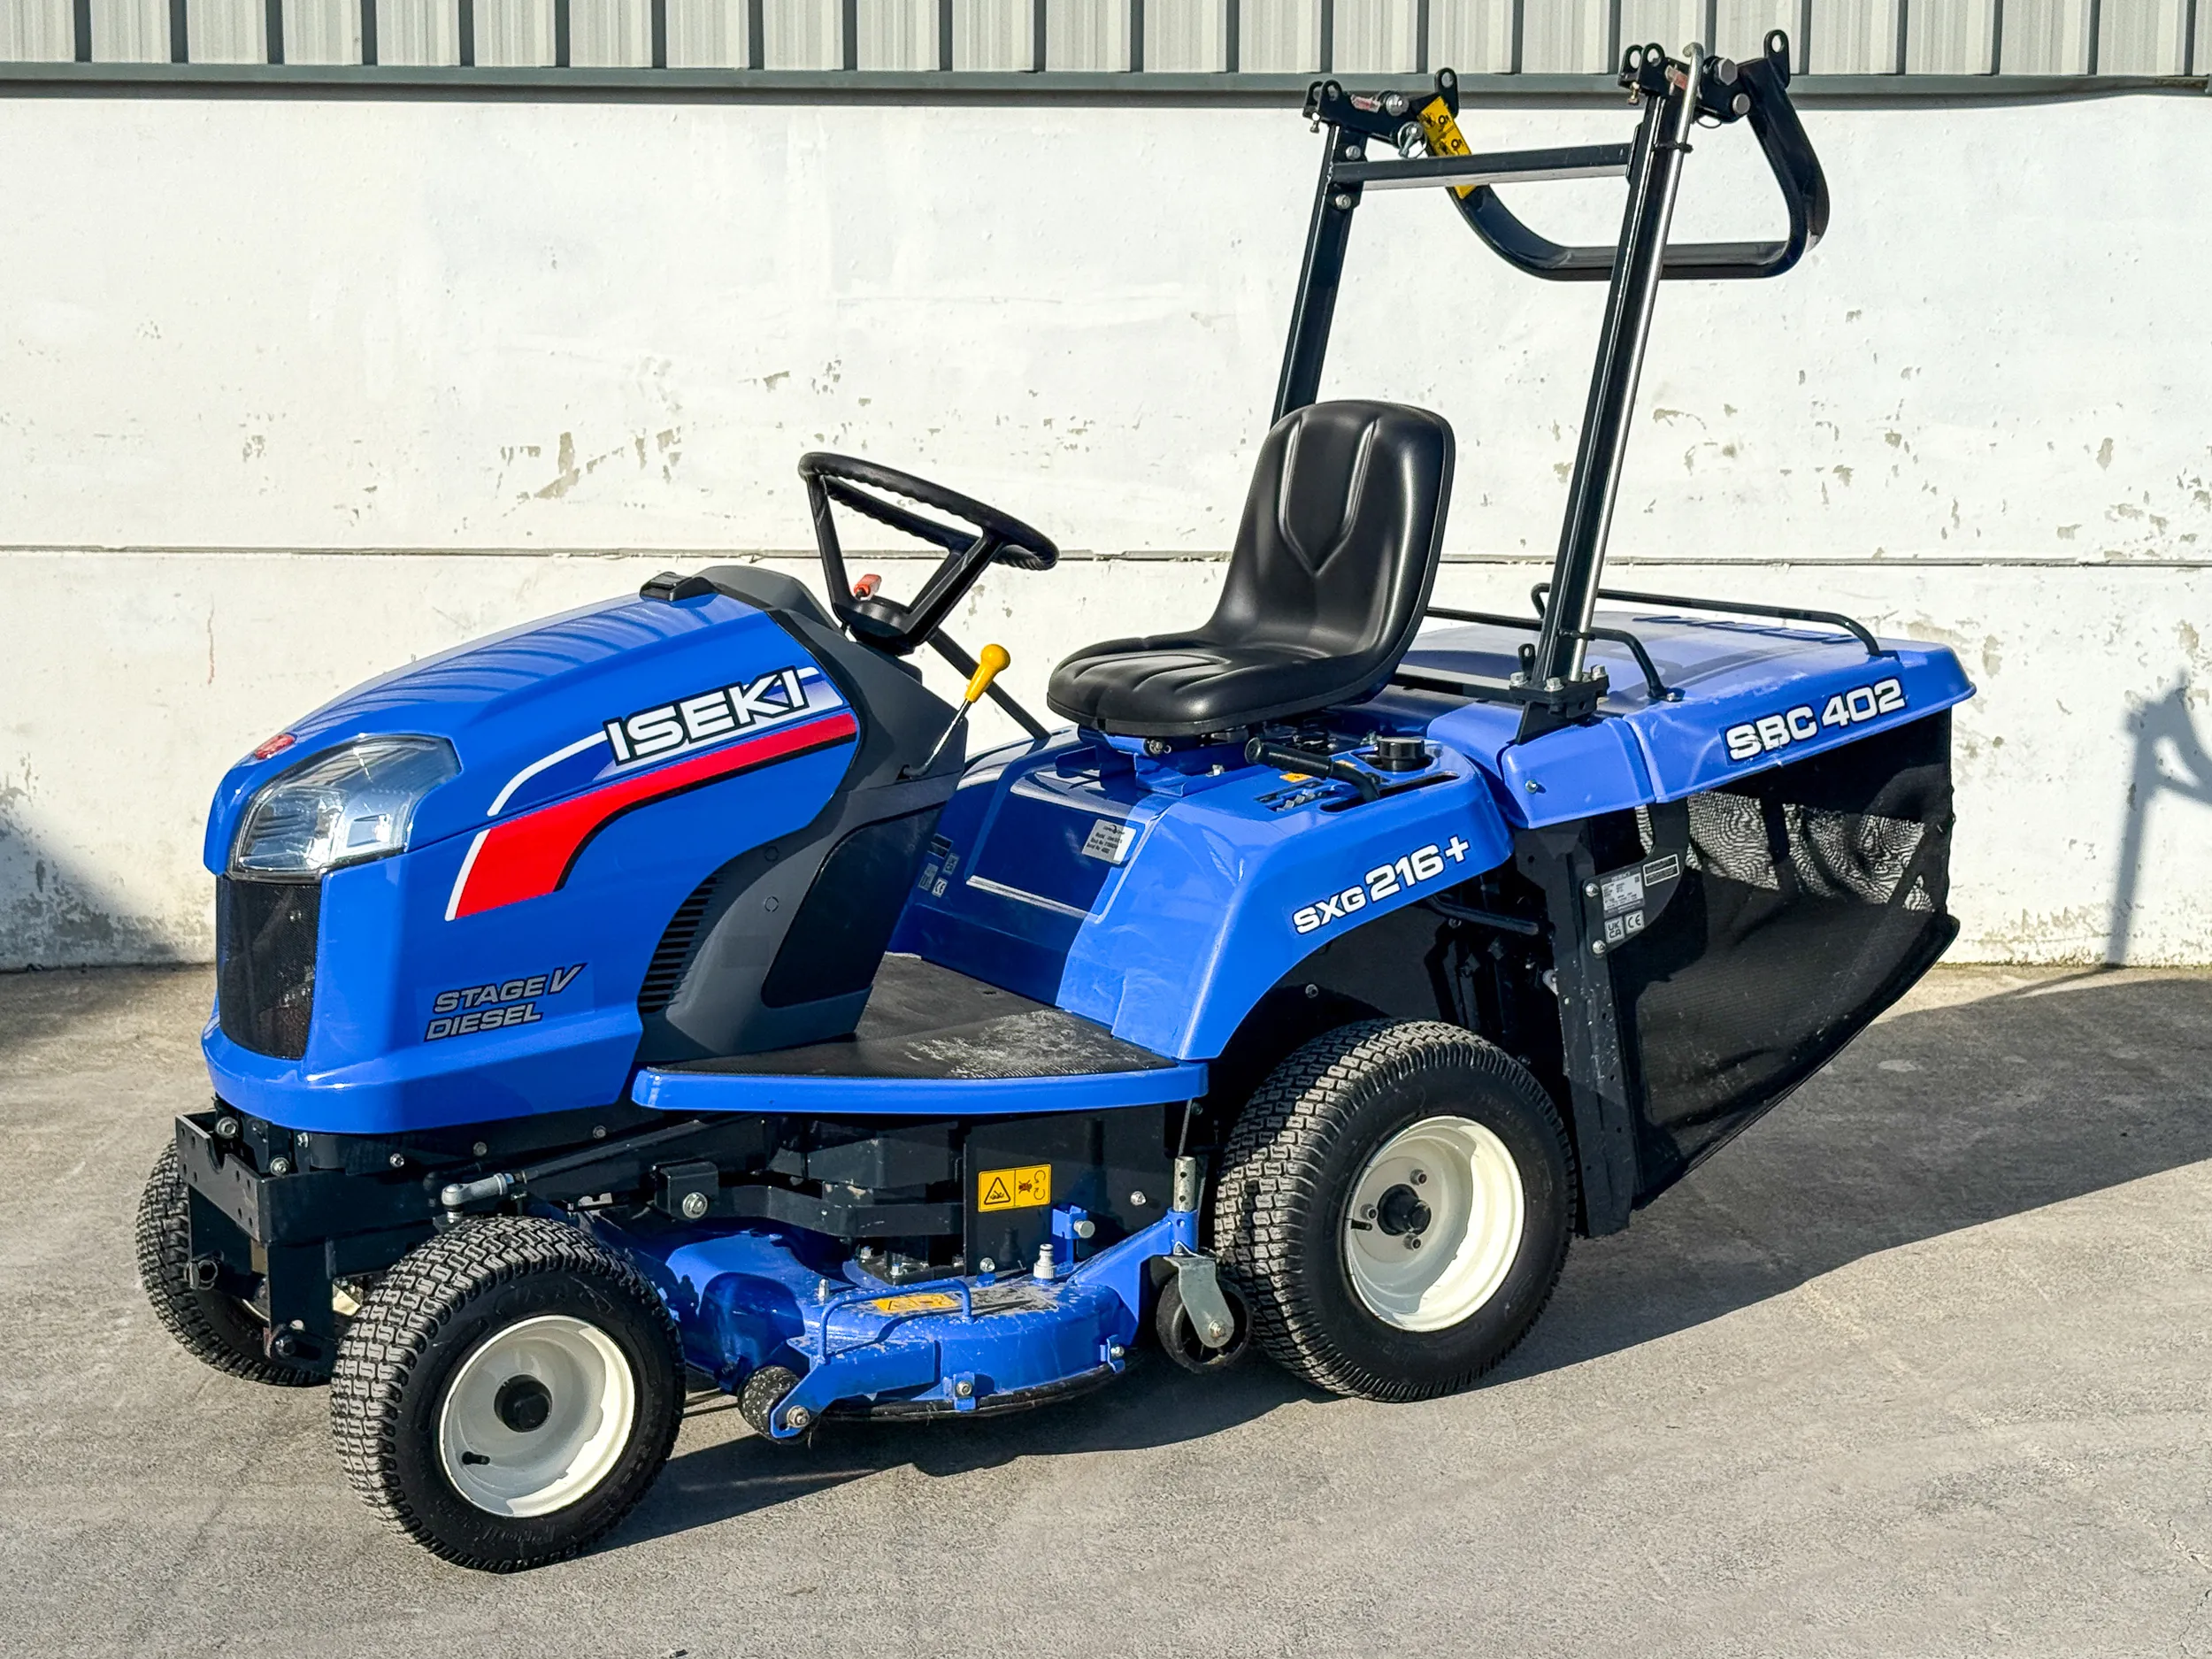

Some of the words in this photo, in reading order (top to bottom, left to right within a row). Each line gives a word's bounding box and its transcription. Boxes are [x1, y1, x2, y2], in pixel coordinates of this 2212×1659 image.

[605, 668, 806, 763] ISEKI
[1725, 706, 1818, 761] SBC
[1821, 678, 1906, 727] 402
[1608, 920, 1620, 931] UK
[1609, 929, 1622, 939] CA
[1627, 914, 1642, 928] CE
[434, 975, 548, 1013] STAGE
[549, 964, 583, 994] V
[426, 1002, 542, 1041] DIESEL
